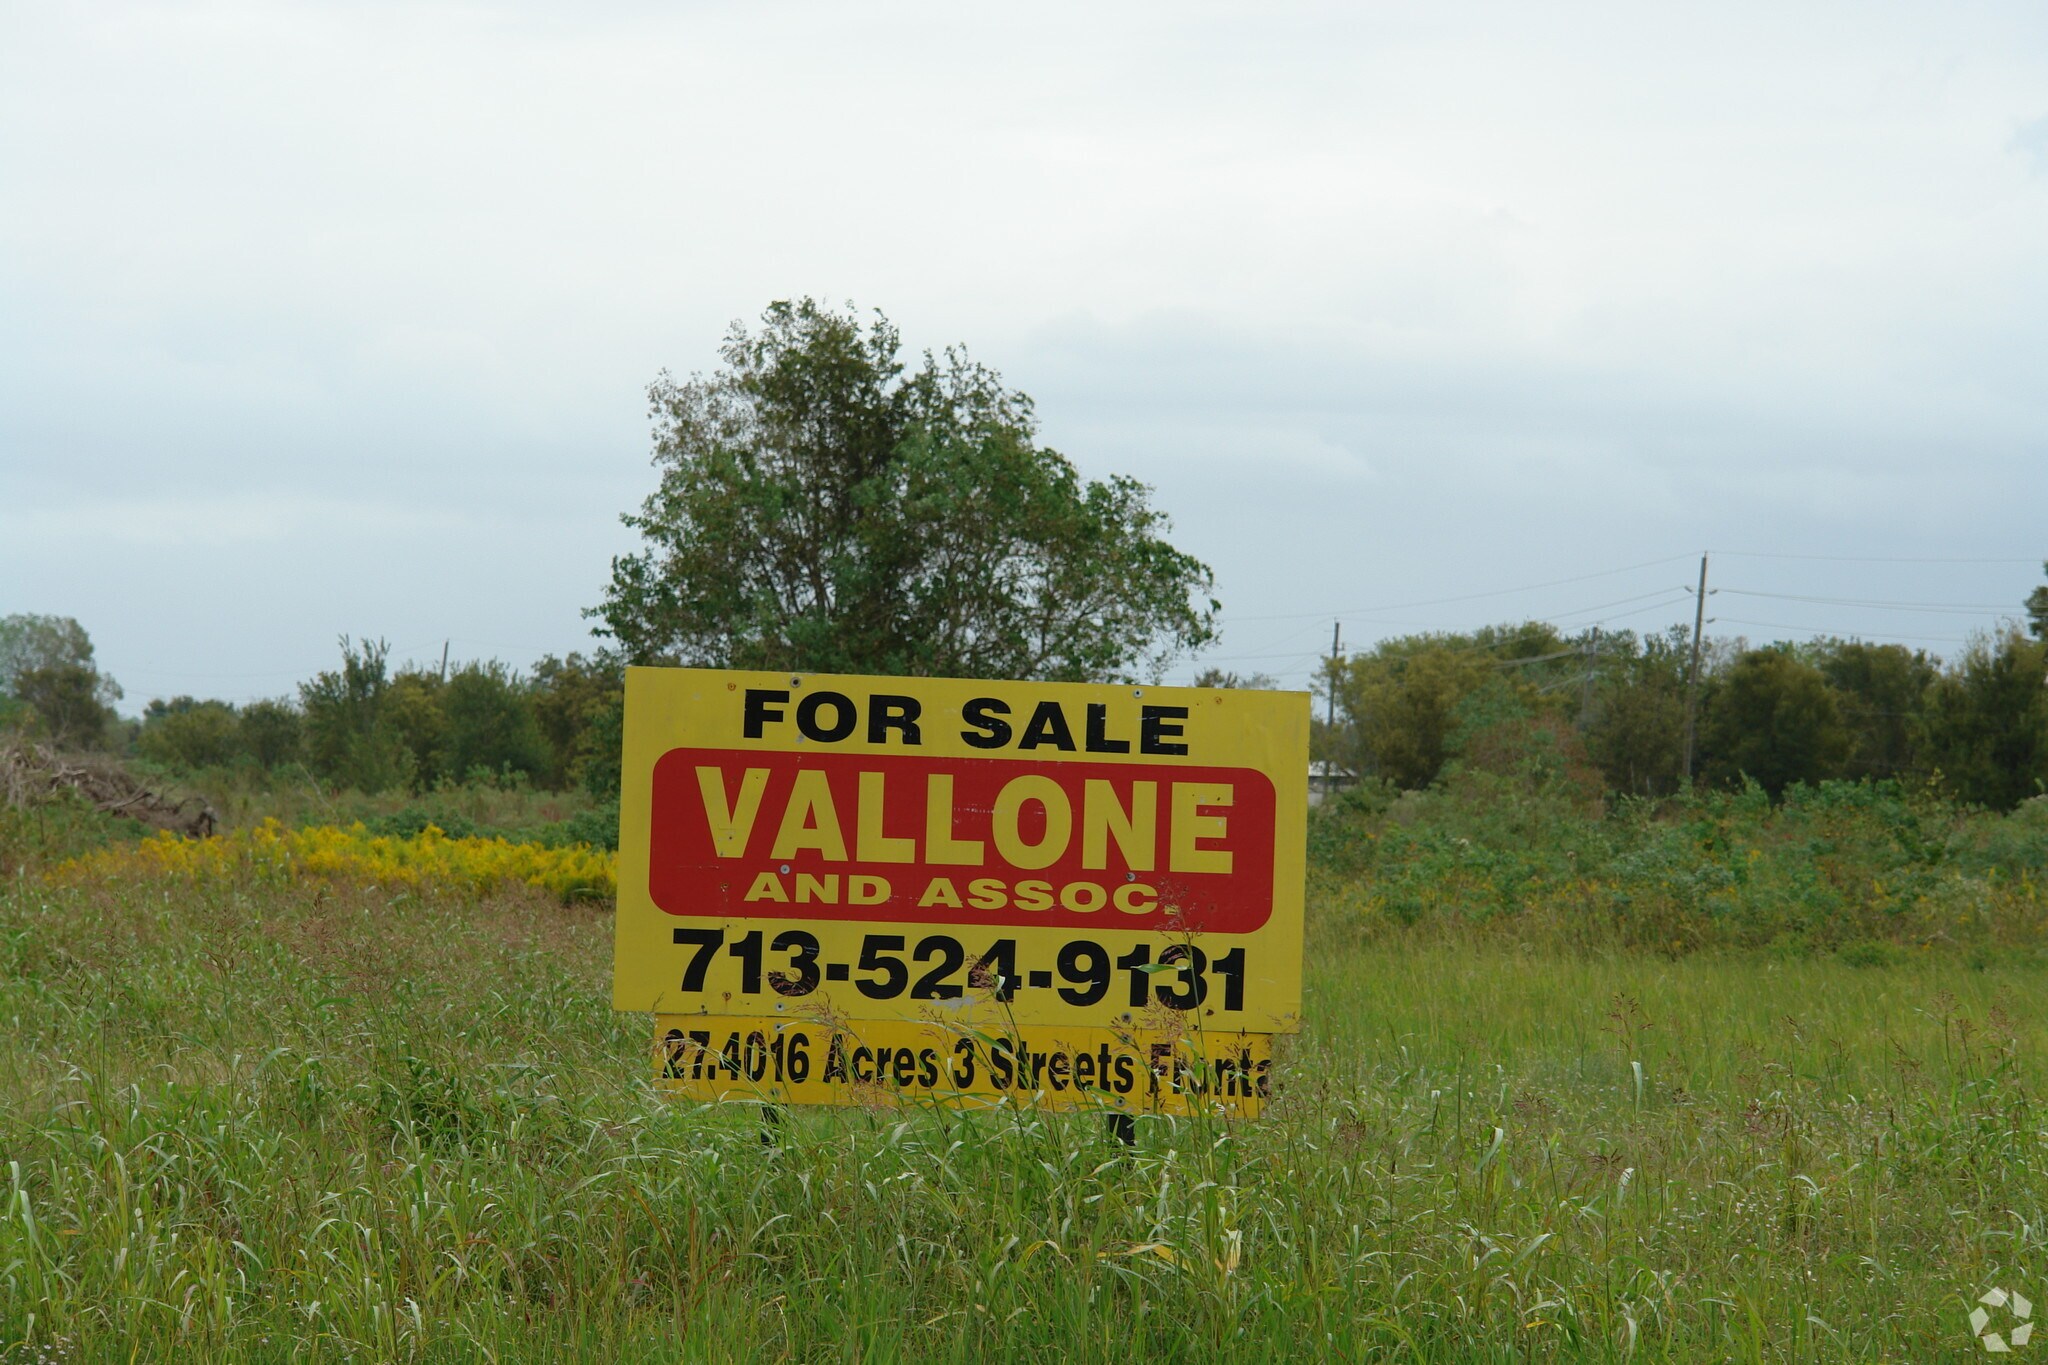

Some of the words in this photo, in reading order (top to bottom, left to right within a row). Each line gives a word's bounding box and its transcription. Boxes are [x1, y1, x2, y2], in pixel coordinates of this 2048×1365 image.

[743, 690, 922, 744] FOR
[960, 698, 1189, 756] SALE
[695, 766, 1234, 873] VALLONE
[743, 873, 892, 906] AND
[672, 928, 1247, 1012] 713-524-9131
[663, 1028, 810, 1084] 27.4016
[822, 1034, 938, 1088] Acres
[953, 1037, 975, 1089] 3
[990, 1038, 1135, 1093] Streets
